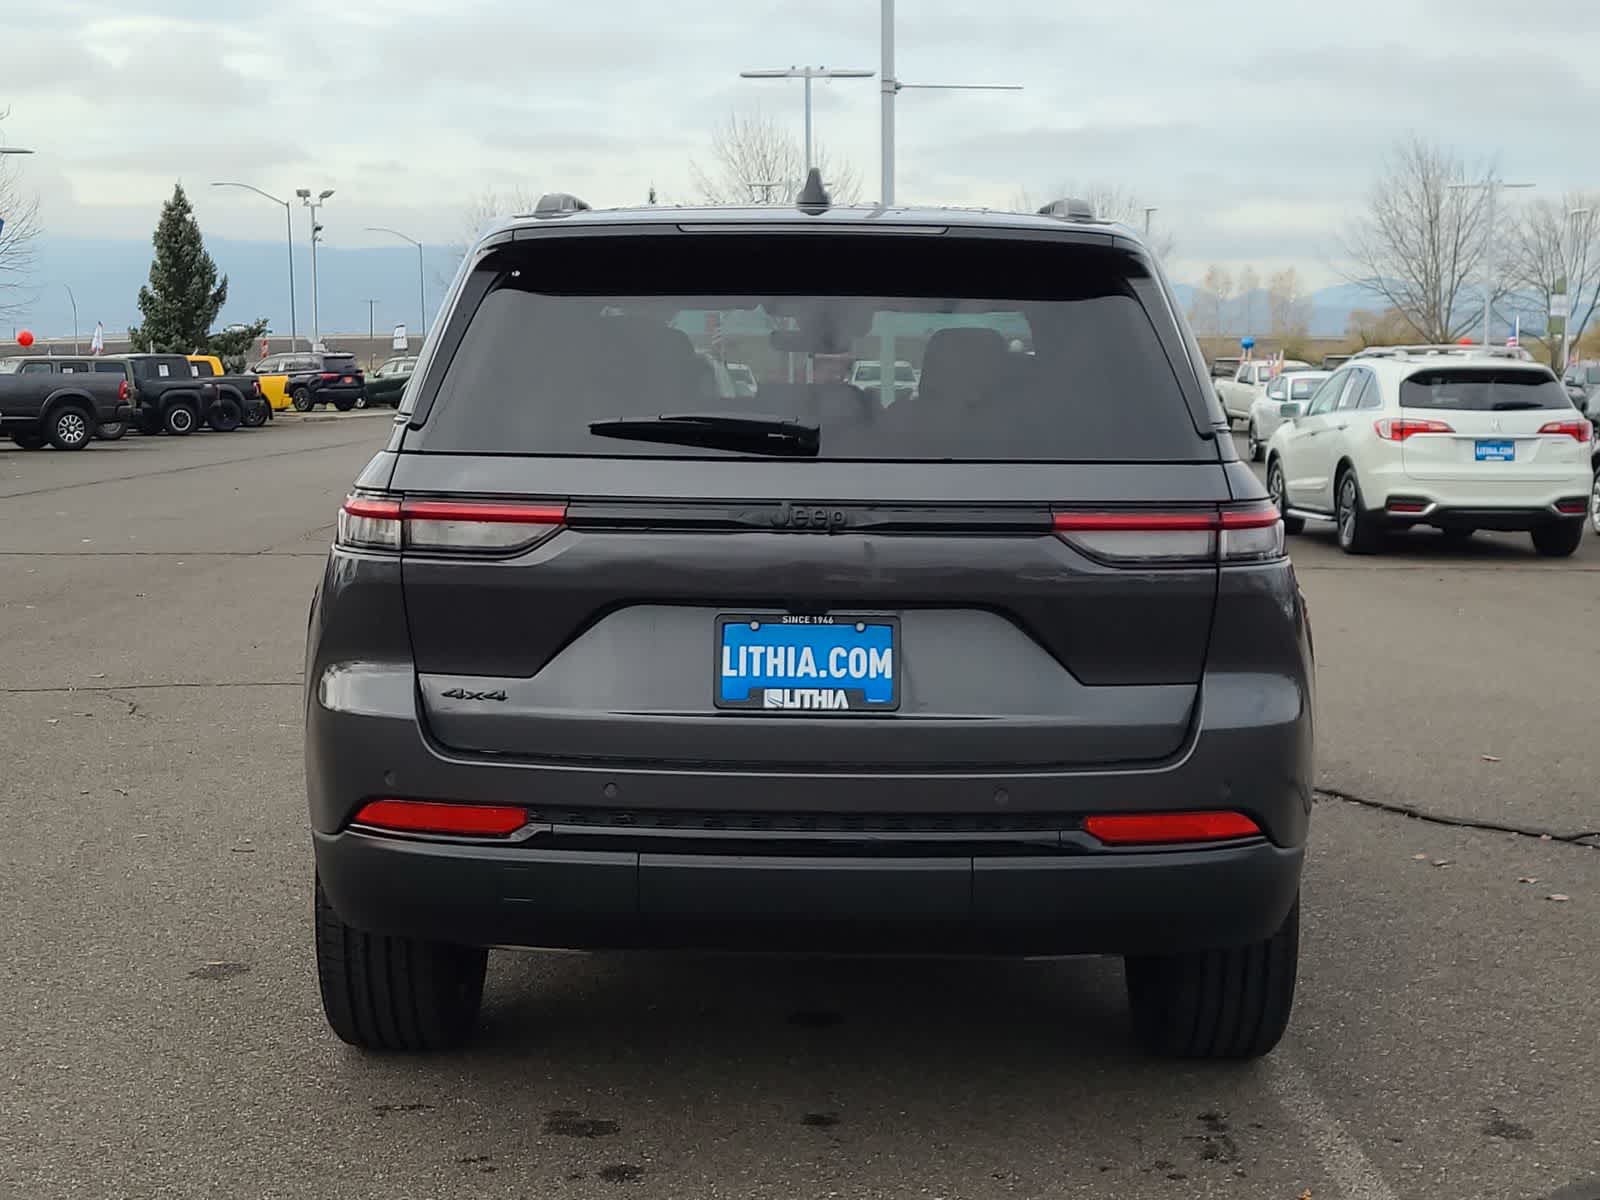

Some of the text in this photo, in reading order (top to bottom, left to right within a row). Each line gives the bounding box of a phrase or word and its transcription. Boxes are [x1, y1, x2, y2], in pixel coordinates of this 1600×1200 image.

[769, 501, 847, 535] Jeep
[782, 615, 834, 625] SINCE 1946
[722, 645, 893, 679] LITHIA.COM
[783, 688, 849, 709] LITHIA
